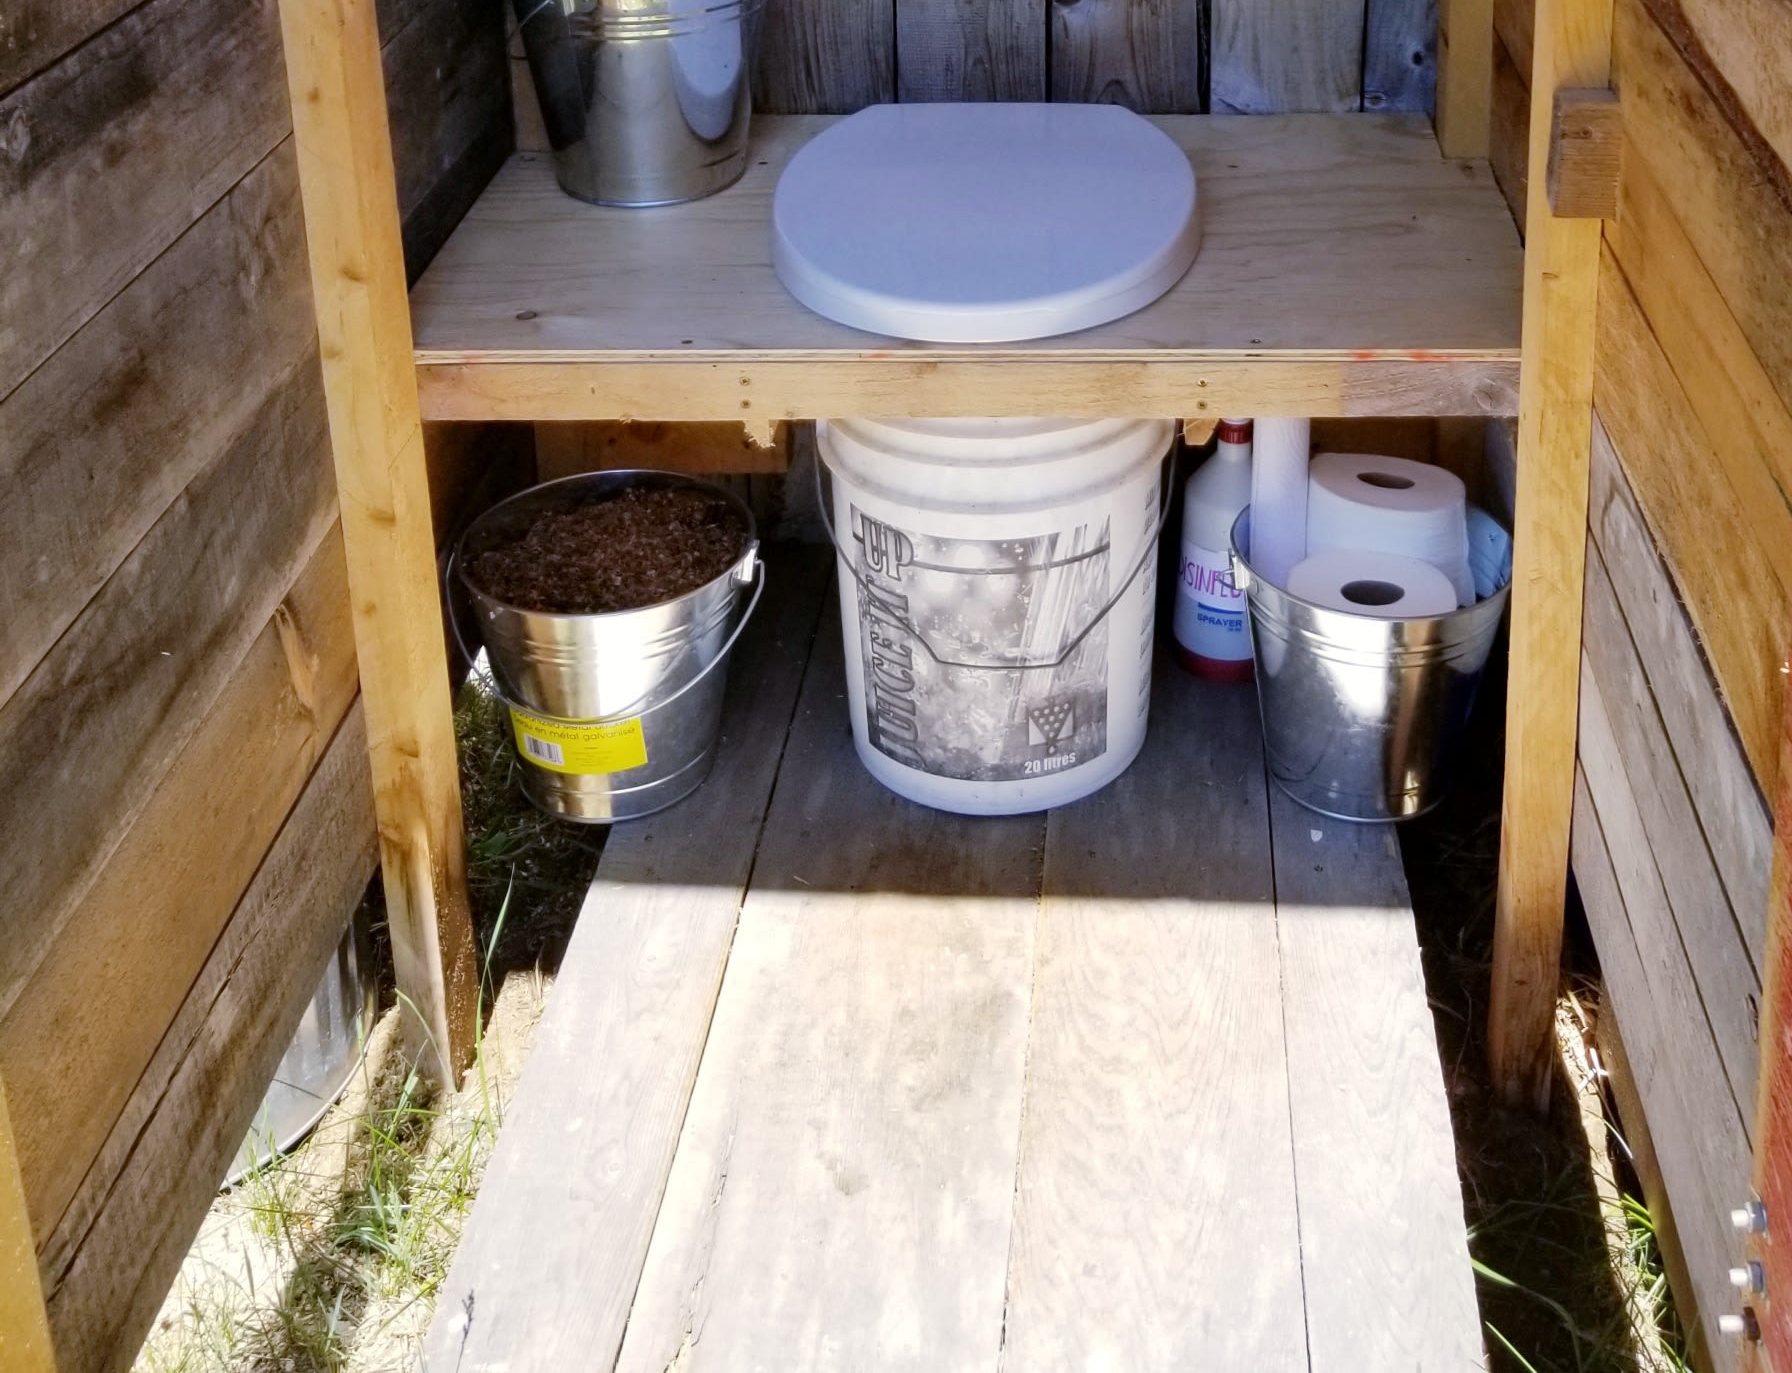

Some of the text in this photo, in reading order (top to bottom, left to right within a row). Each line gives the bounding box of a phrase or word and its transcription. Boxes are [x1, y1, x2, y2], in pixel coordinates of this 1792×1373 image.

[1197, 613, 1242, 628] SPRAYER
[1024, 752, 1076, 774] 20 litres
